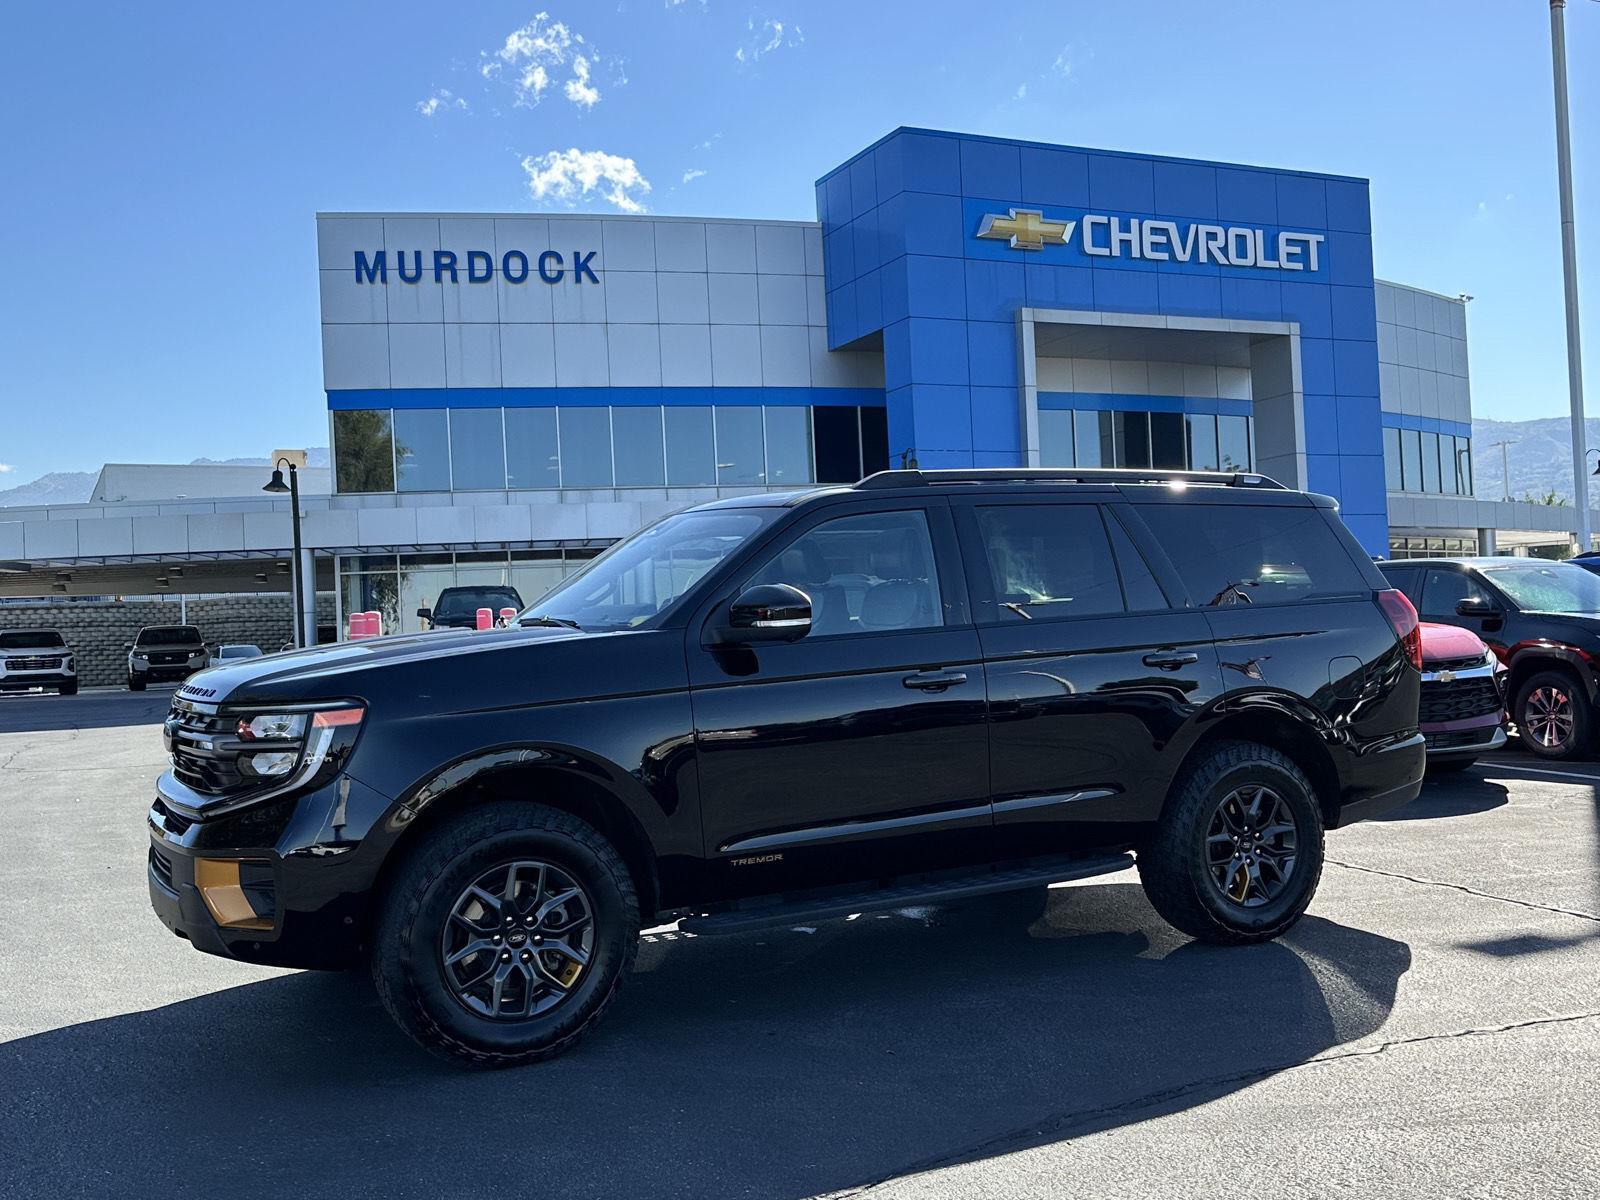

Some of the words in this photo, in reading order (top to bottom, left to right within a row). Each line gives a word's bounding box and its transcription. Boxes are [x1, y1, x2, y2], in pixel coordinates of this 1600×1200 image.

[1082, 214, 1325, 272] CHEVROLET
[354, 250, 600, 284] MURDOCK
[730, 853, 784, 867] TREMOR
